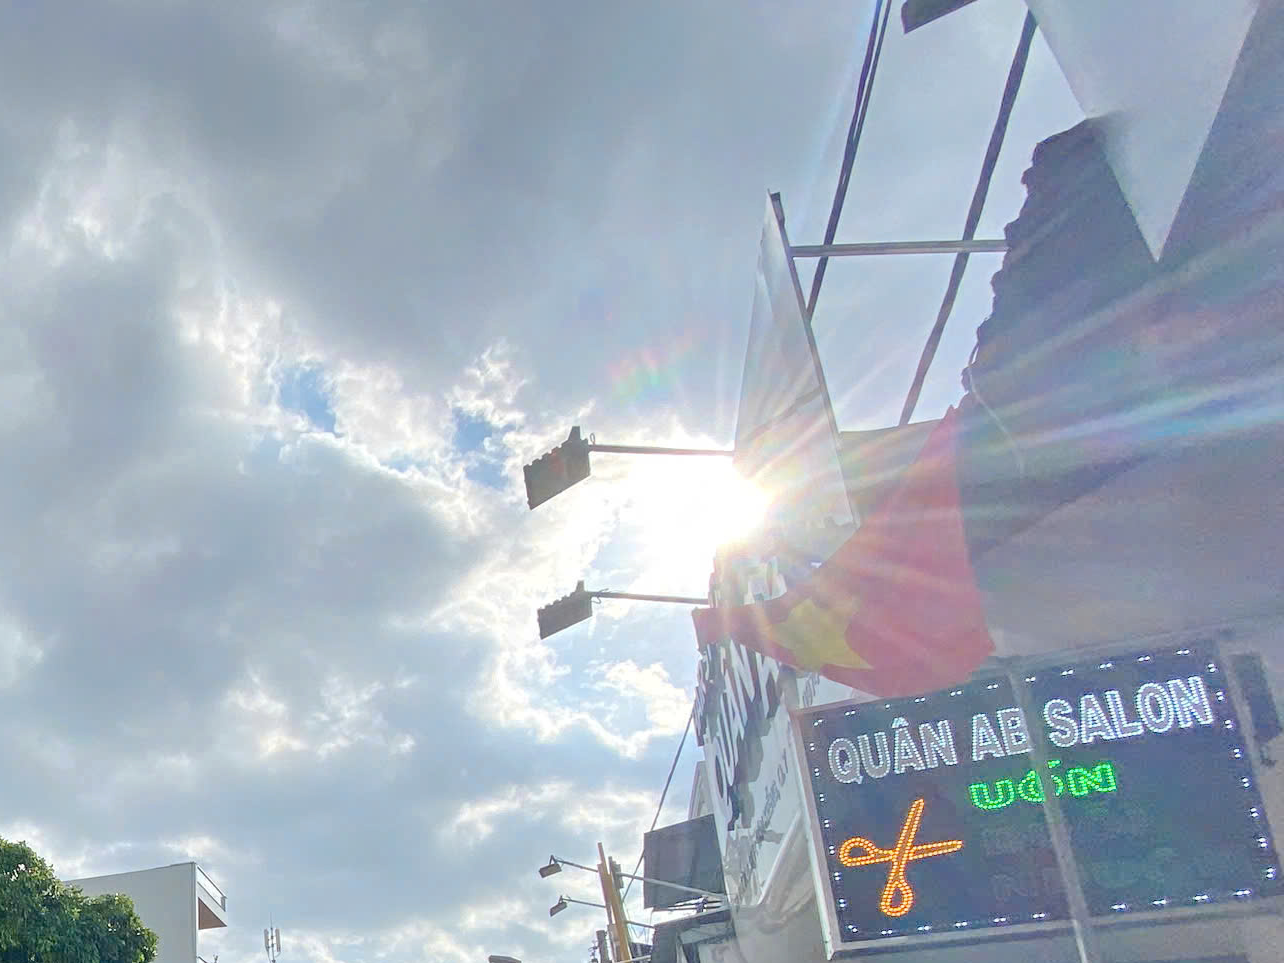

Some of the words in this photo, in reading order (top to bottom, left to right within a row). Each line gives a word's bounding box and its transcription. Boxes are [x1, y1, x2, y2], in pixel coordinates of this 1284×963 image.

[827, 716, 958, 785] QUÂN
[971, 707, 1034, 762] AB
[1042, 675, 1214, 748] SALON
